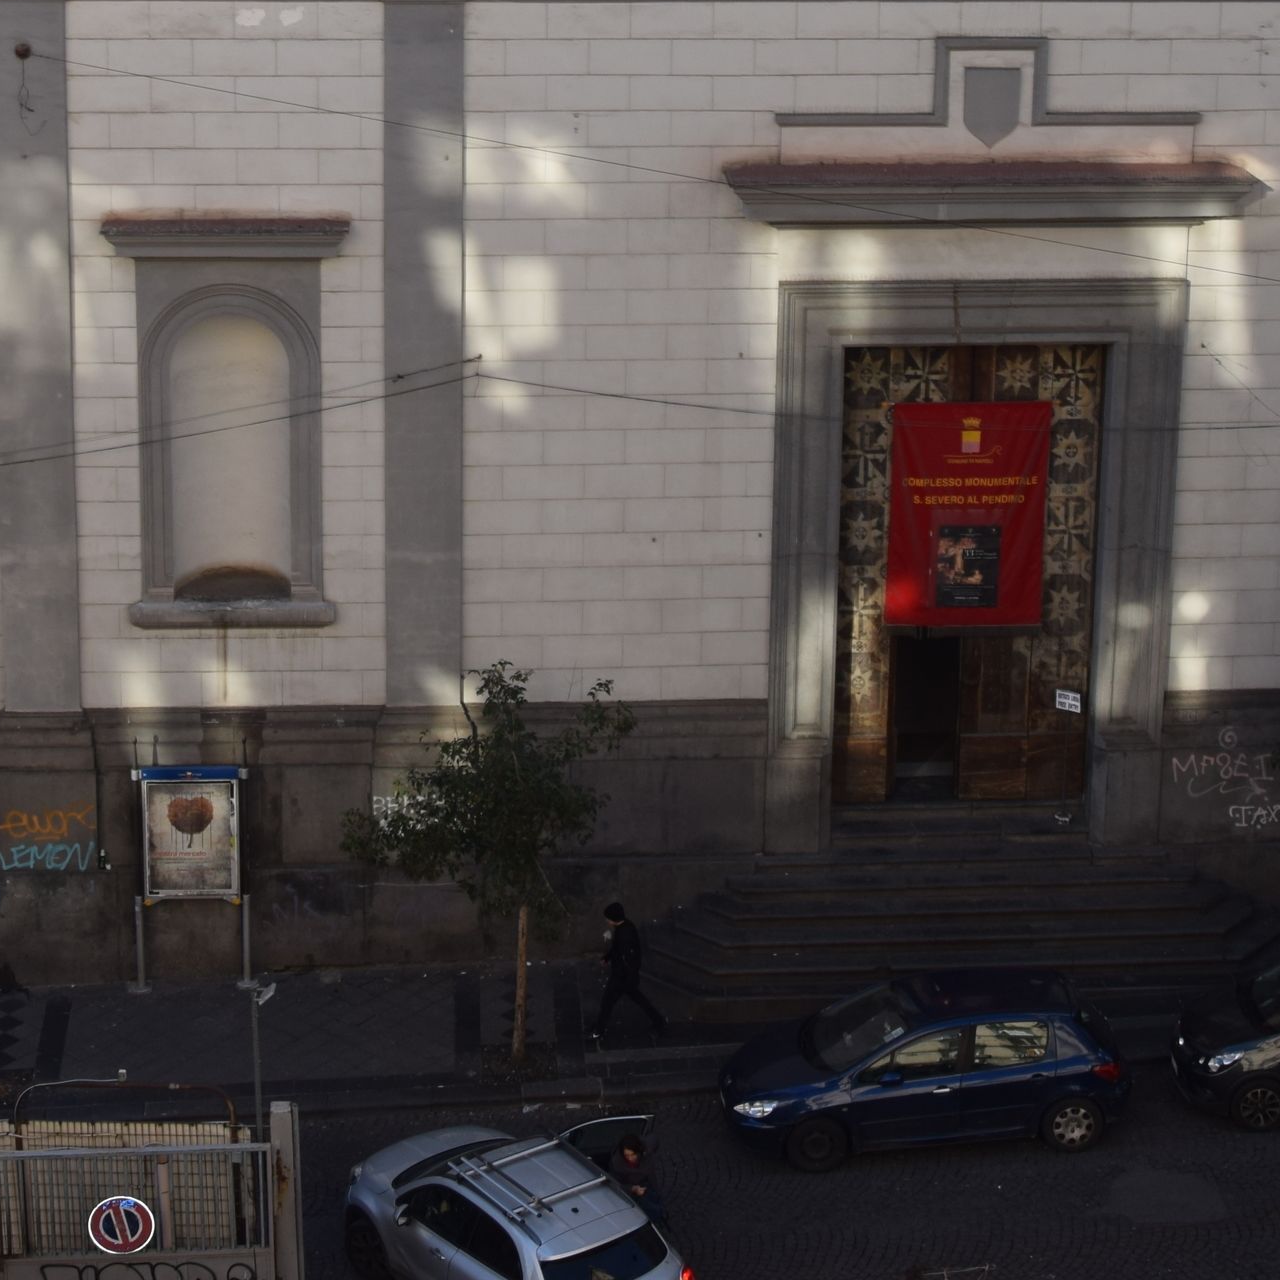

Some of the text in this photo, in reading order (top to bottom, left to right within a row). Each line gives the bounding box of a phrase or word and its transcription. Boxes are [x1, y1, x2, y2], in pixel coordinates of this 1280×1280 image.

[903, 475, 1040, 488] COMPLESSO MONUMENTALE
[912, 493, 1025, 506] S. SEVERO AL PENDINO
